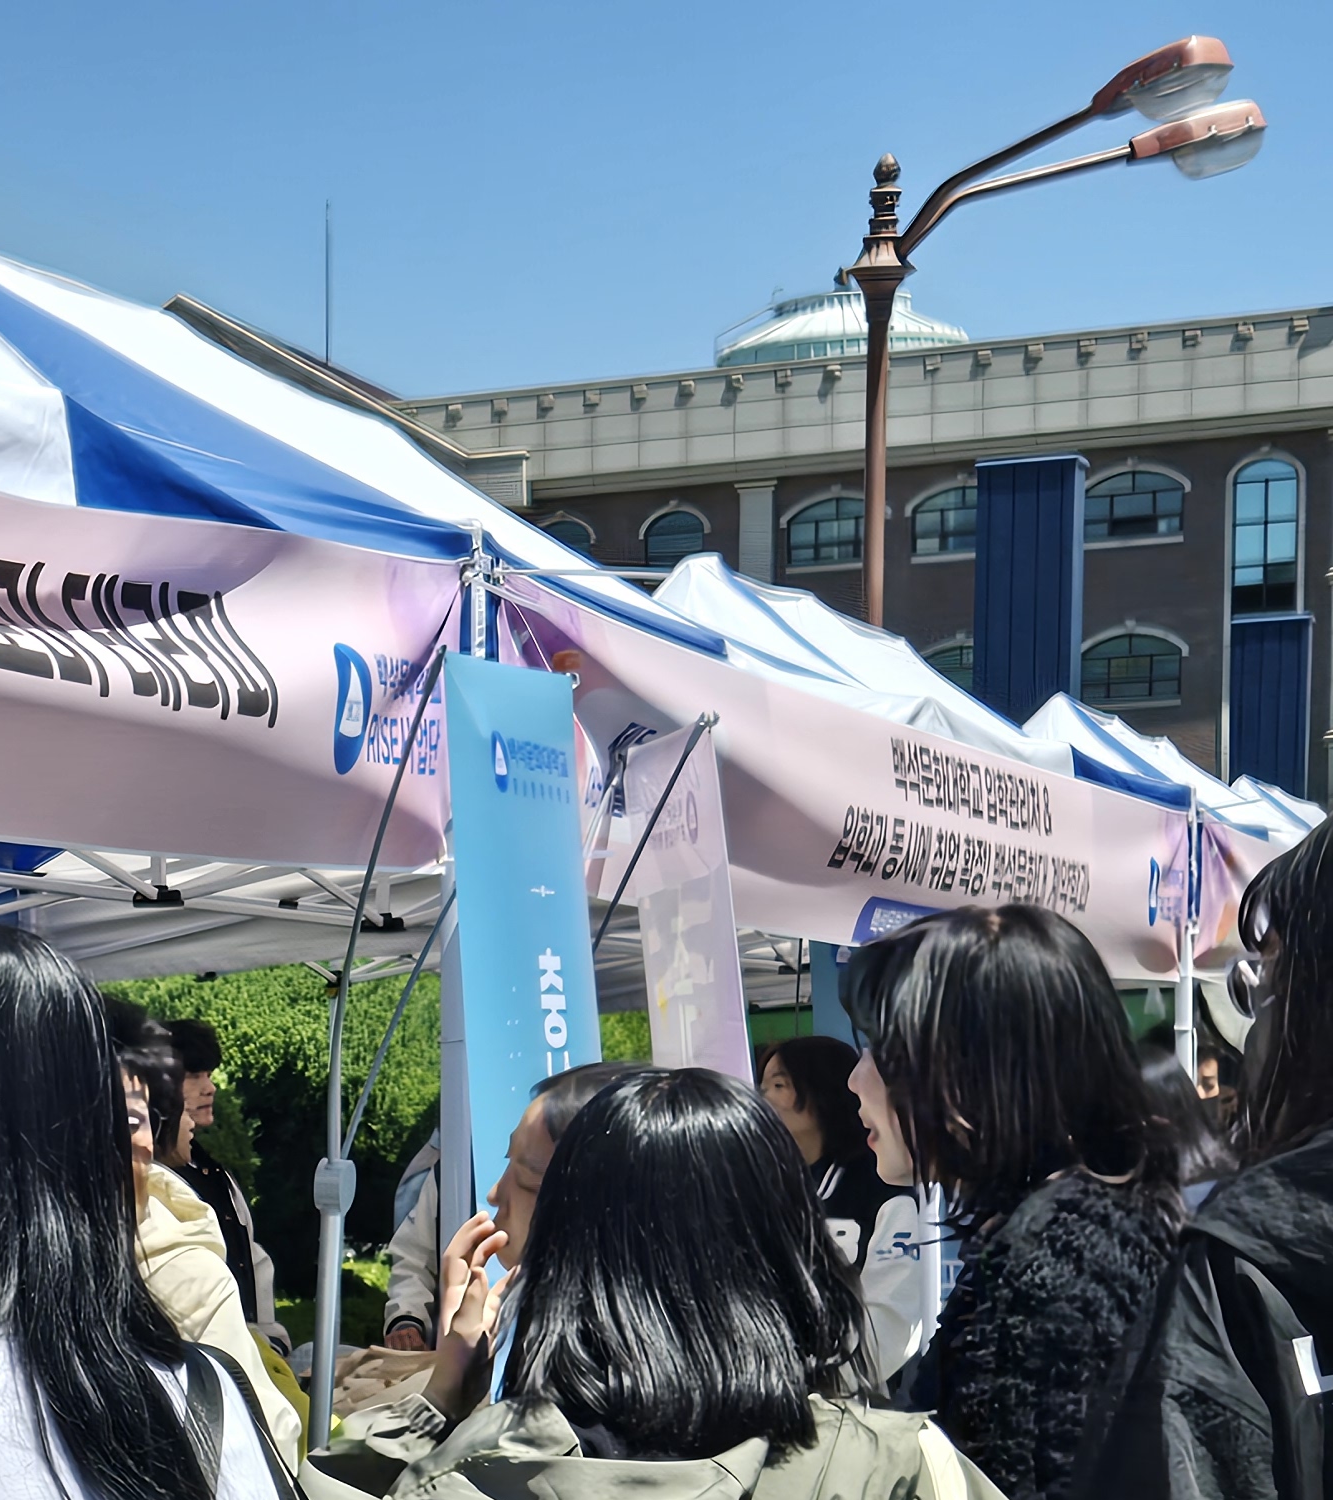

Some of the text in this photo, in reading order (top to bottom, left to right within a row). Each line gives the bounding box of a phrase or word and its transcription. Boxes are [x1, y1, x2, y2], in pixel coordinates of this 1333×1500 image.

[890, 736, 984, 819] 백석문화대학교
[984, 766, 1042, 837] 입학관리처
[826, 804, 889, 878] 입학과
[880, 817, 934, 886] 동시에
[928, 827, 961, 892] 취업
